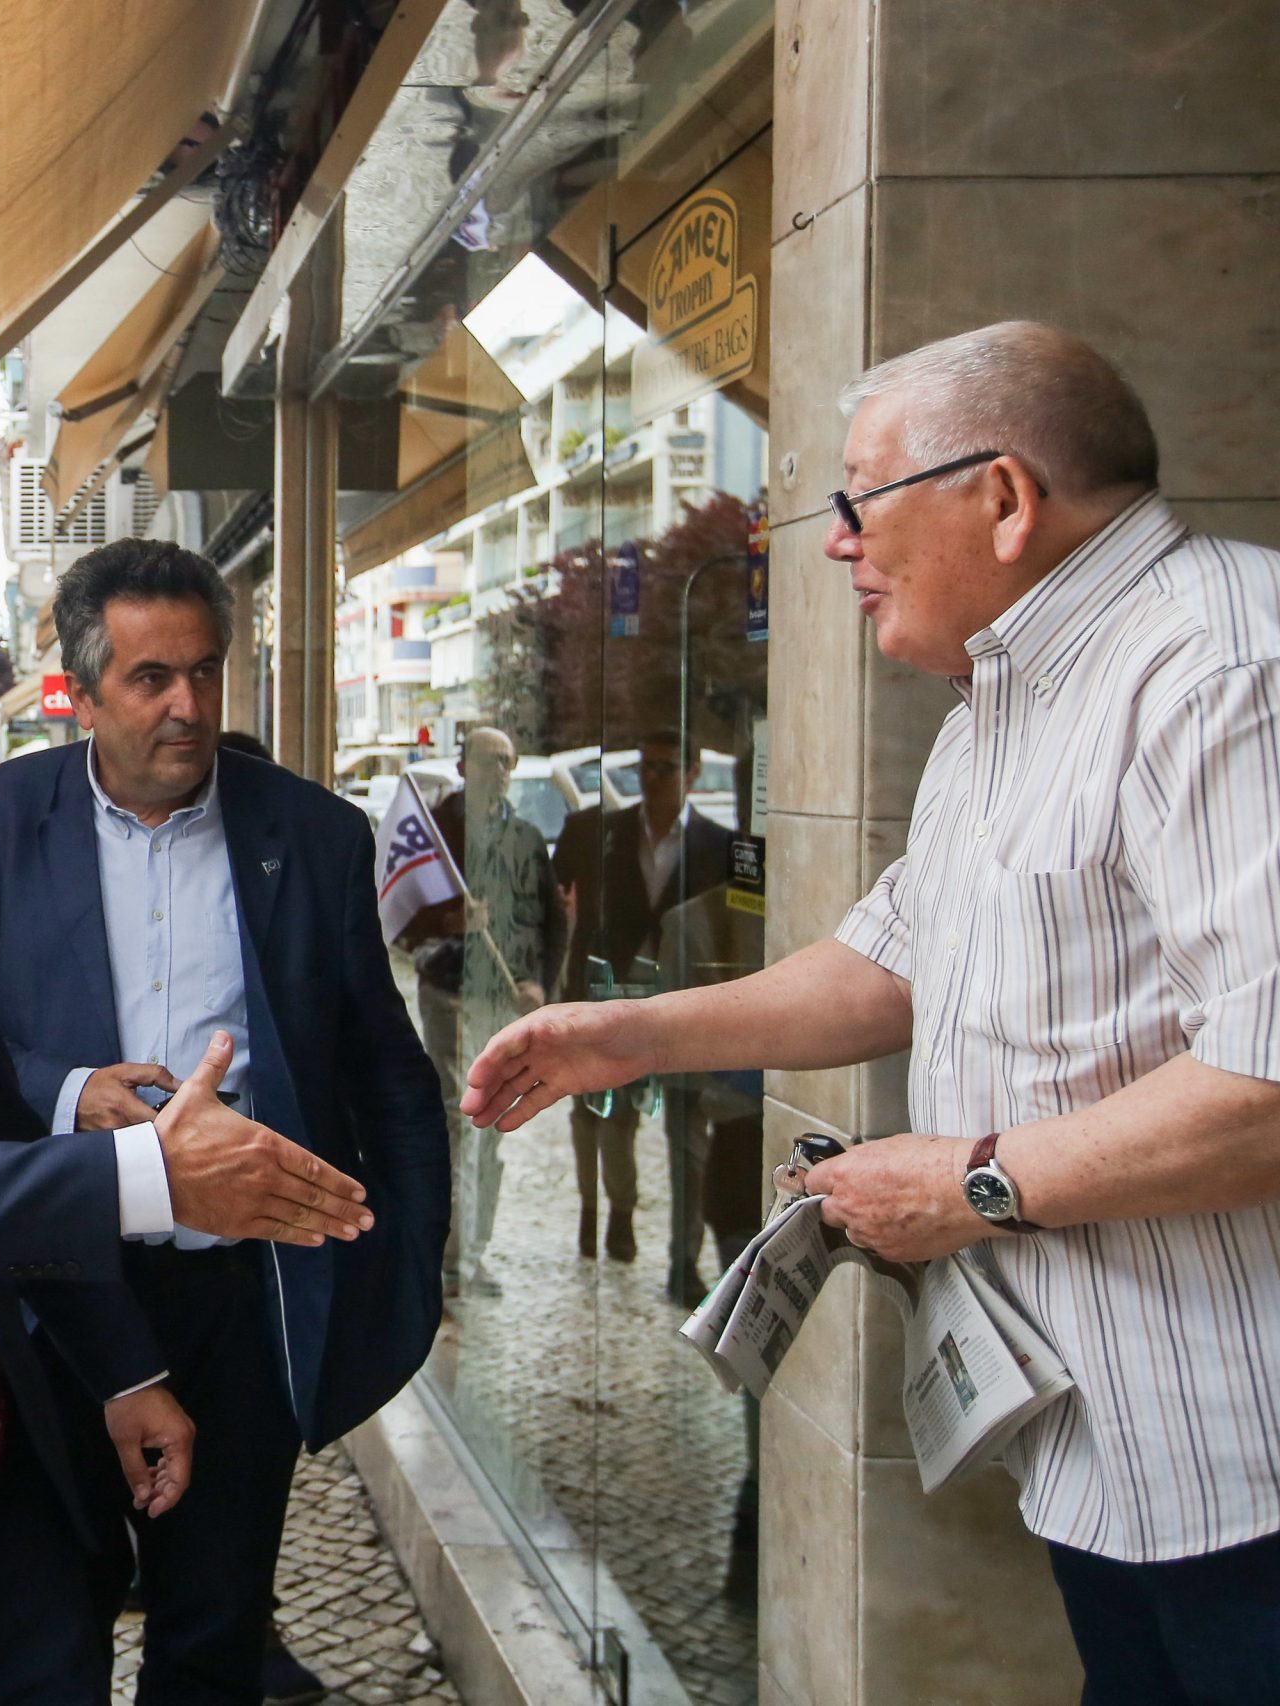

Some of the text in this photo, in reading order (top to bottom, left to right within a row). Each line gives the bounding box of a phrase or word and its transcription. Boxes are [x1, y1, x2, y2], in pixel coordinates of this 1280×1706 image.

[654, 211, 730, 310] CAMEL
[668, 273, 714, 325] TROPHY
[715, 313, 749, 364] BAGS
[734, 863, 758, 877] active
